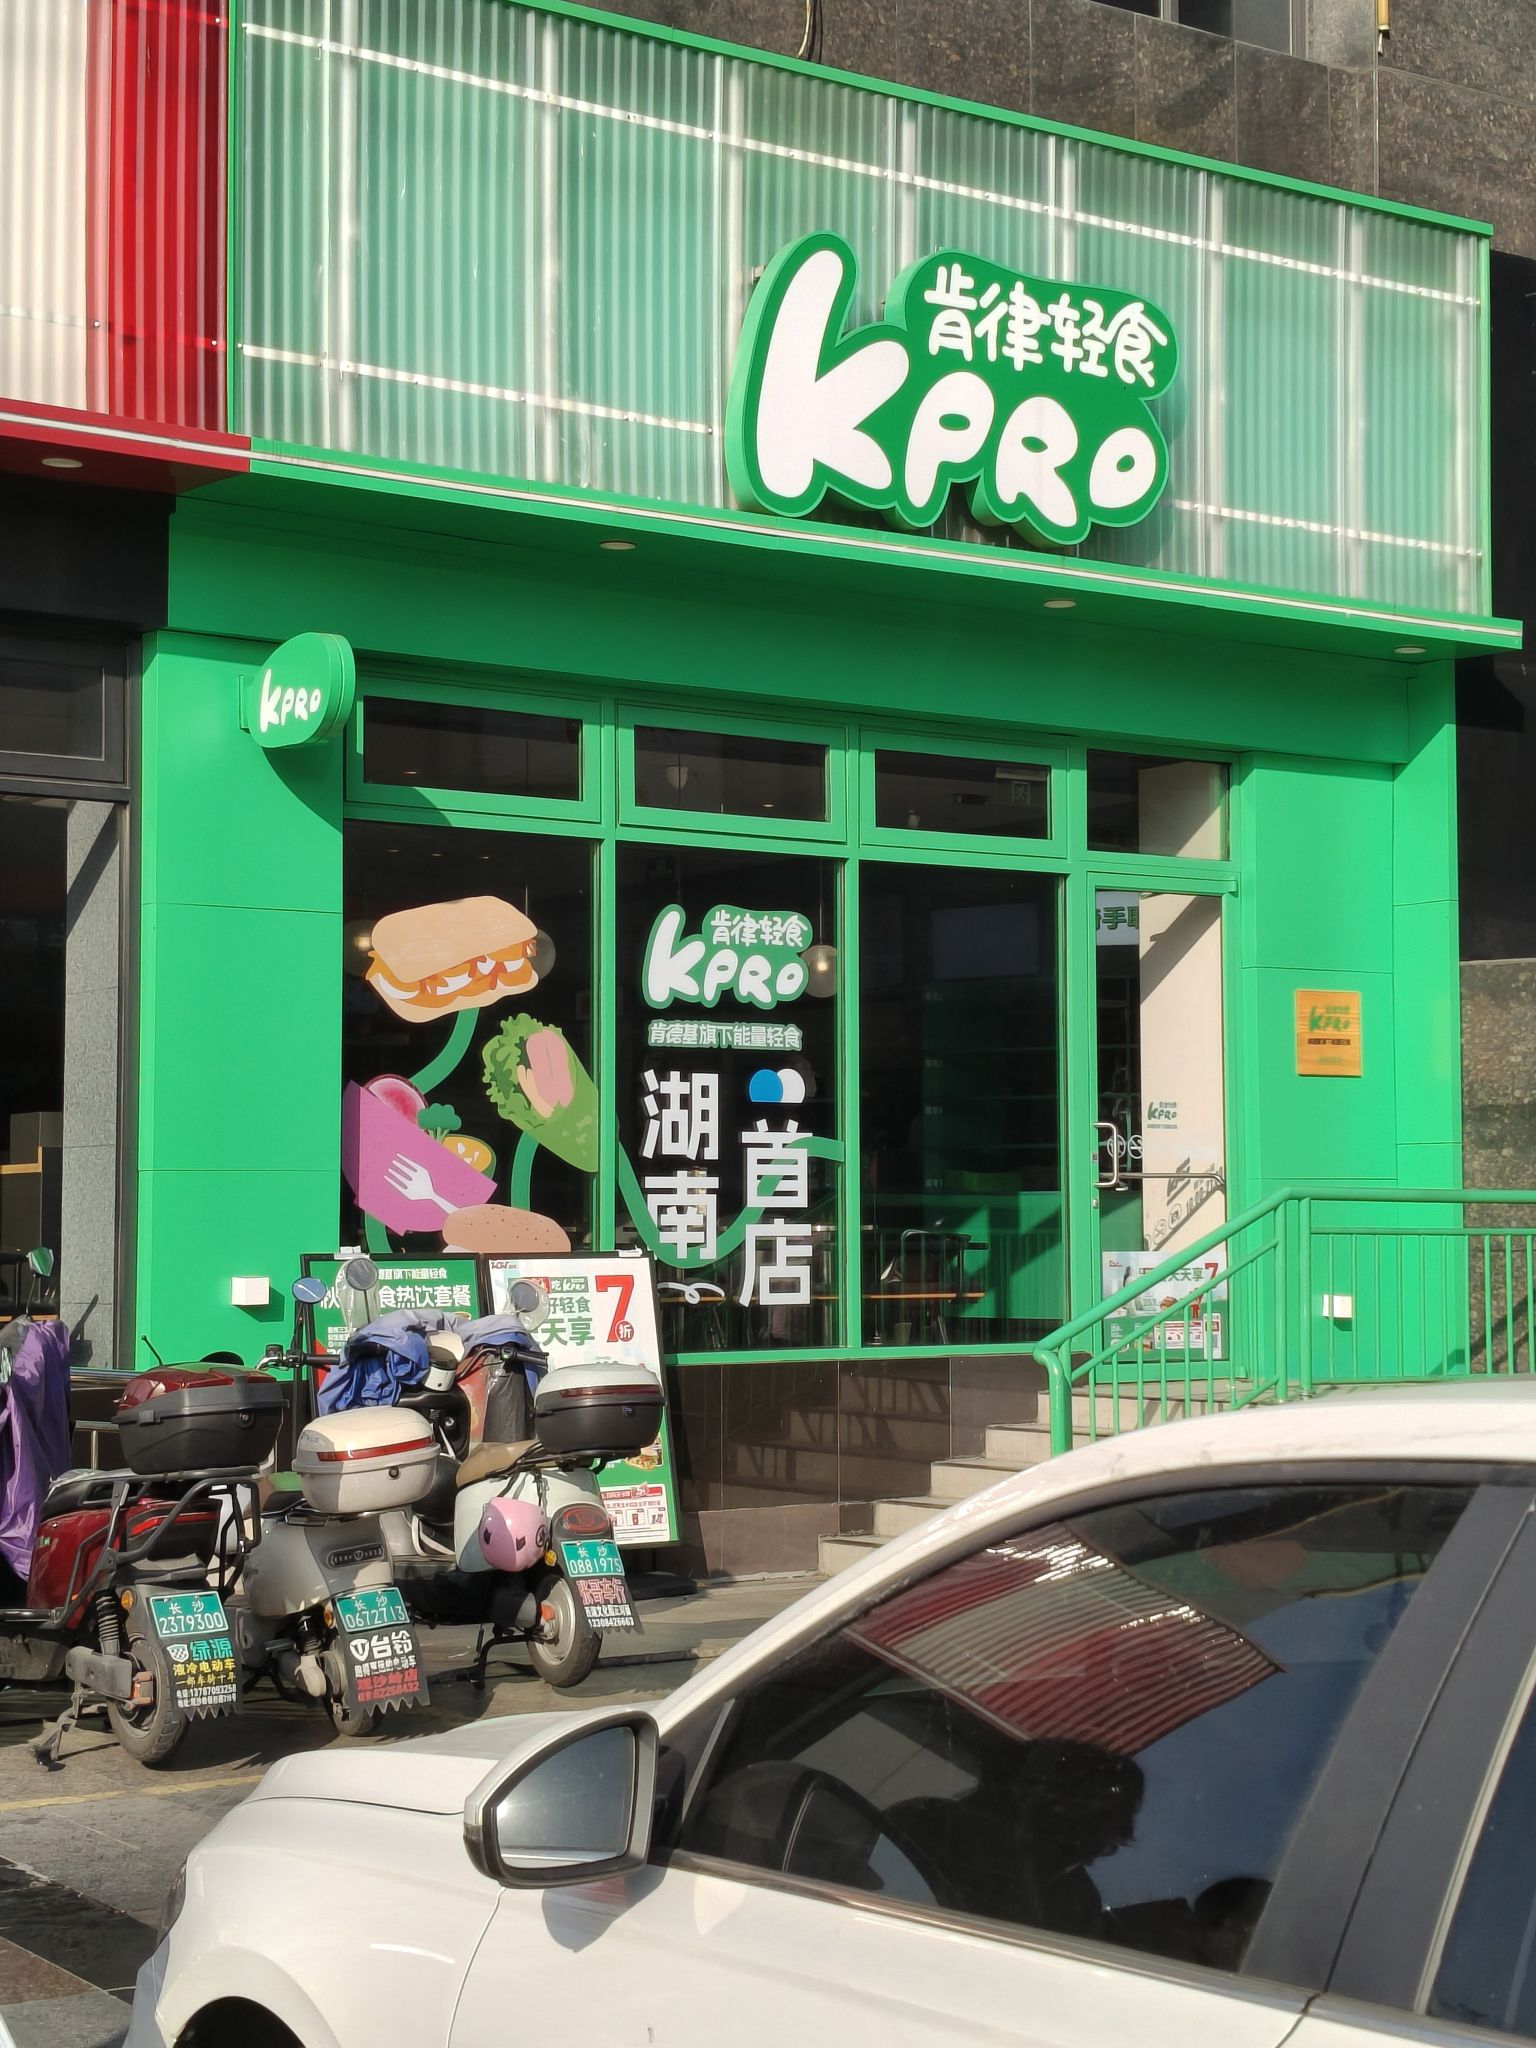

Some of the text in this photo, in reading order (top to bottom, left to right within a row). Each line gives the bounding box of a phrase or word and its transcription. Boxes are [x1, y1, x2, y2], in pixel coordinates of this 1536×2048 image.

[924, 263, 1168, 388] 肯律轻食
[710, 909, 808, 948] 肯律轻食
[650, 1023, 801, 1048] 肯德基旗下能量轻食
[643, 1069, 719, 1260] 湖南
[739, 1118, 813, 1308] 首店
[595, 1275, 634, 1343] 7
[618, 1322, 634, 1341] 折
[577, 1545, 609, 1558] 长沙
[569, 1557, 621, 1574] 0881975
[169, 1600, 205, 1615] 长沙
[354, 1596, 388, 1611] 长沙
[159, 1612, 223, 1634] 2379300
[345, 1605, 405, 1628] 0672713
[190, 1638, 233, 1661] 绿源
[371, 1630, 413, 1659] 台铃
[173, 1658, 235, 1676] 液冷电动车
